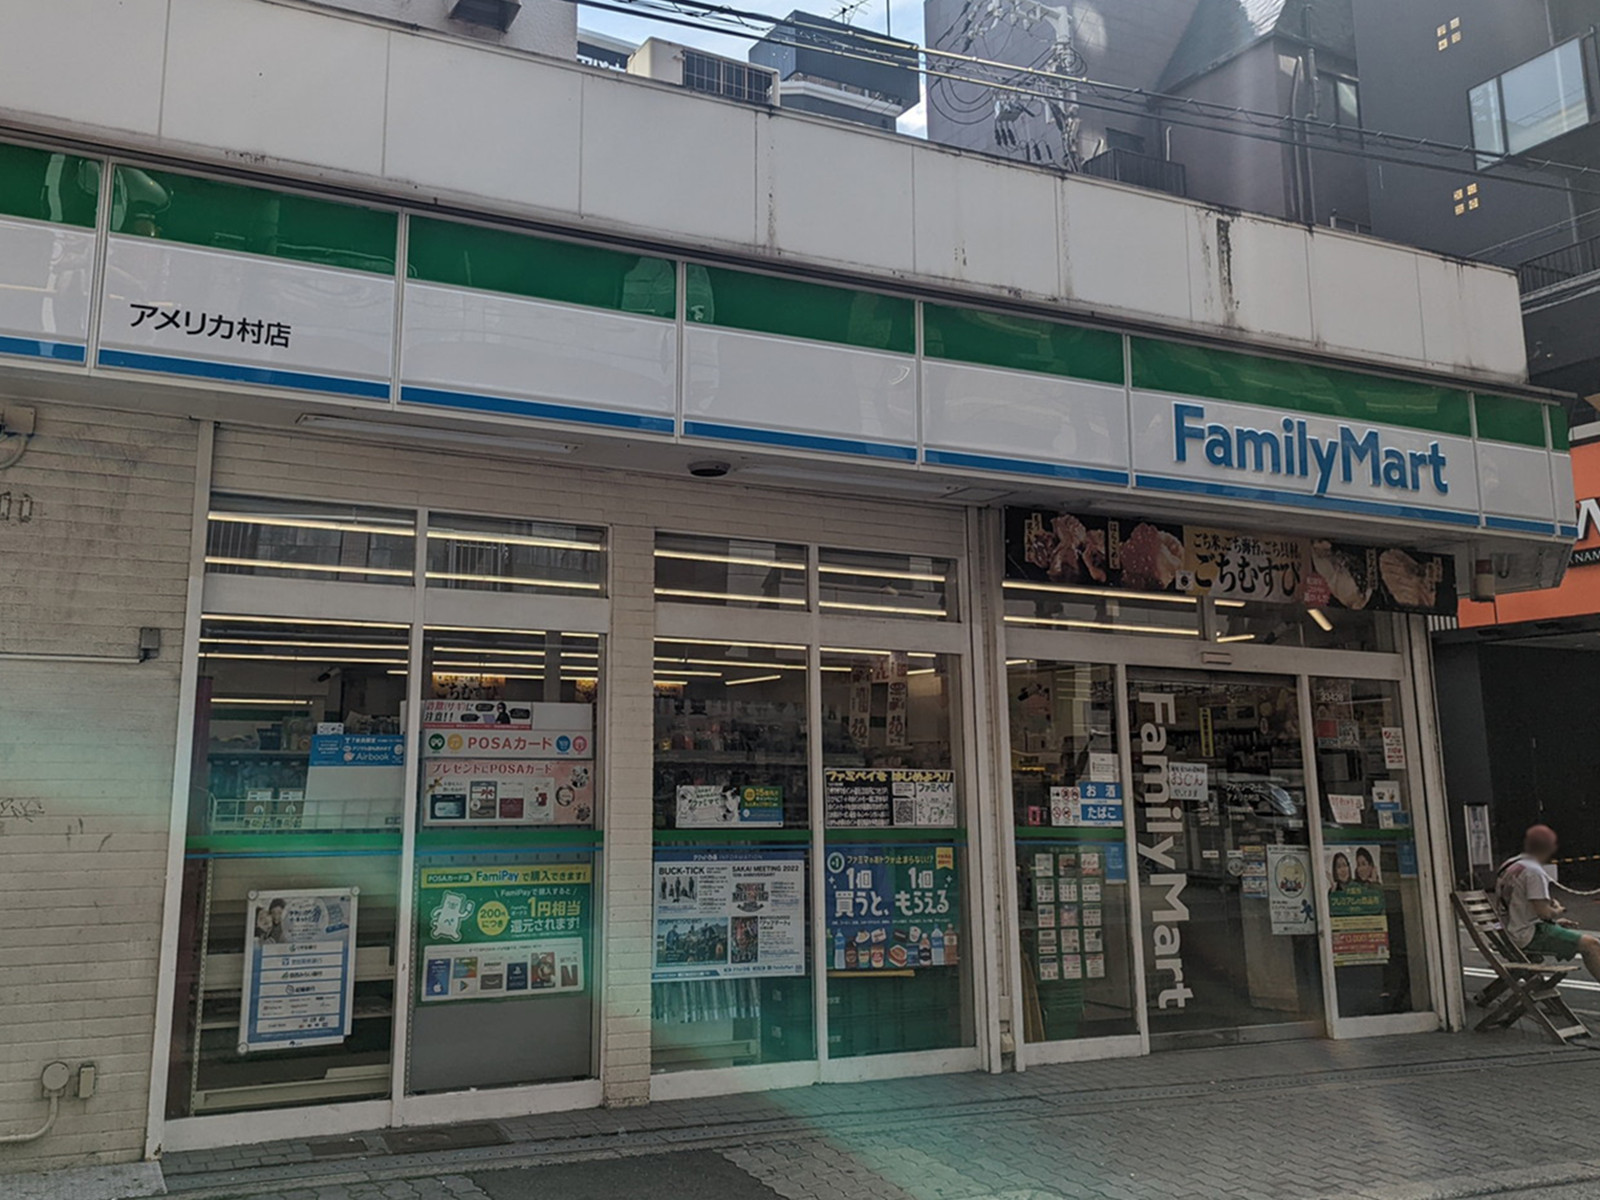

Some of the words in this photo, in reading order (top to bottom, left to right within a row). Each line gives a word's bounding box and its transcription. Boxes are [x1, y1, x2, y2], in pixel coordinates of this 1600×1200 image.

[129, 303, 292, 349] アメリカ村店
[1172, 401, 1449, 496] FamilyMart
[1194, 552, 1302, 598] ごちむすび
[467, 736, 552, 750] POSAカード
[355, 753, 389, 761] Airbook
[433, 763, 552, 775] プレゼントにPOSAカード
[917, 783, 951, 792] ファミペイ
[1086, 784, 1116, 798] お酒
[1087, 806, 1117, 819] たばこ
[1138, 692, 1194, 1009] FamilyMart
[846, 867, 872, 890] 1個
[908, 867, 933, 889] 1個
[527, 897, 581, 918] 1円相当
[895, 890, 950, 916] もらえる
[481, 919, 504, 929] につき
[510, 917, 580, 933] 還元されます!
